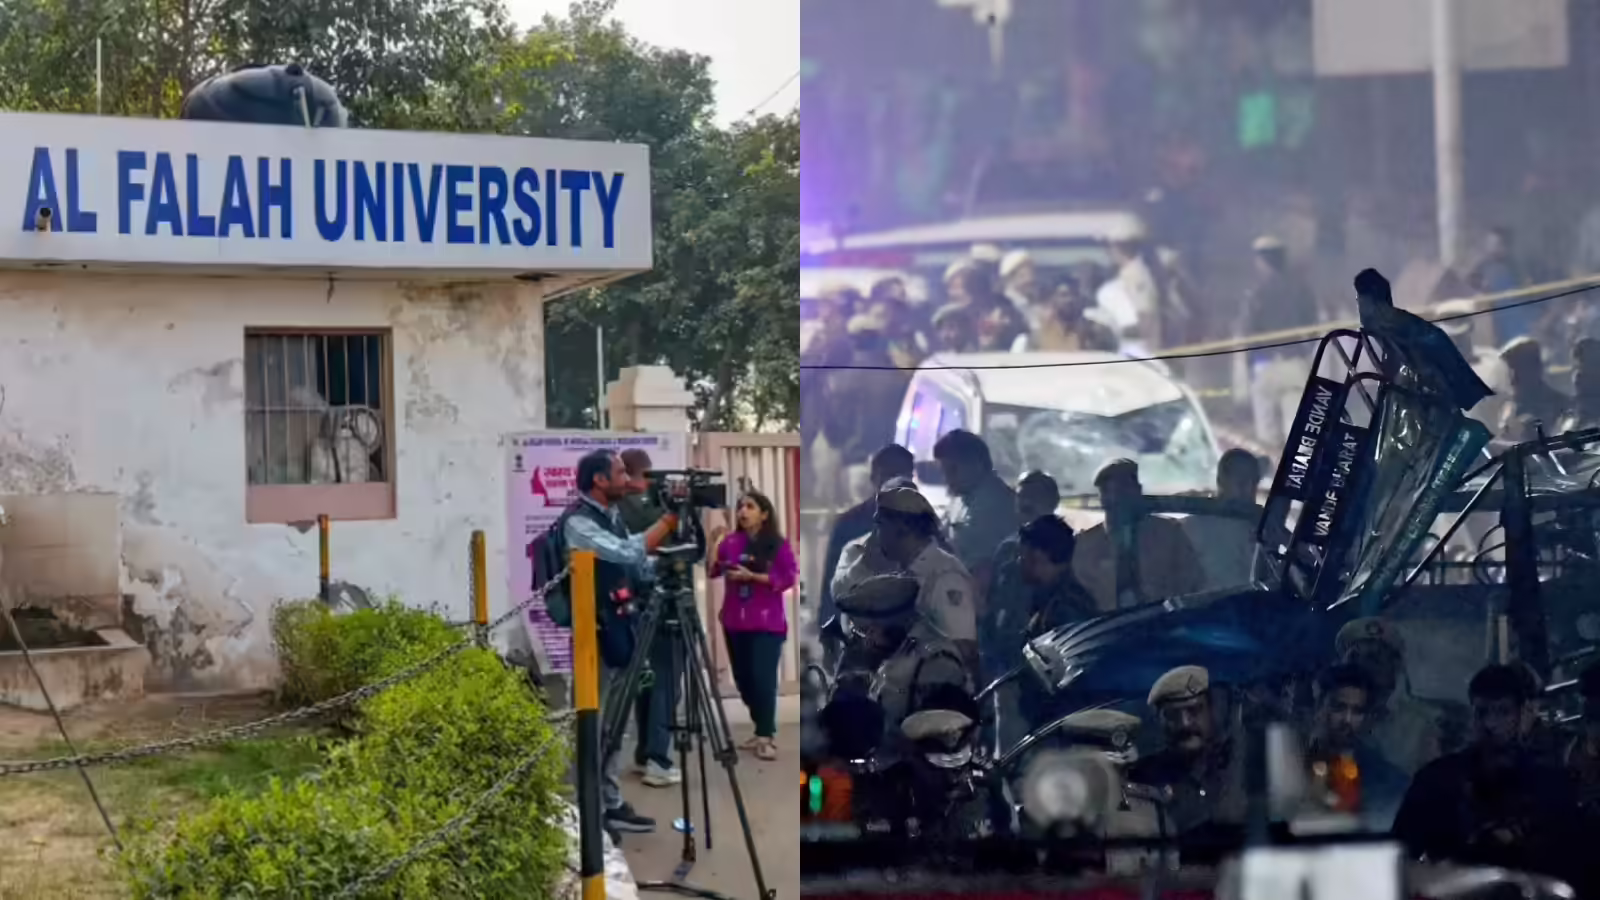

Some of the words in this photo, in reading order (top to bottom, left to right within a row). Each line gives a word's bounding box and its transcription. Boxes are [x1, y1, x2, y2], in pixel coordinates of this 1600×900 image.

[22, 147, 97, 232] AL
[116, 150, 292, 239] FALAH
[313, 159, 625, 248] UNIVERSITY
